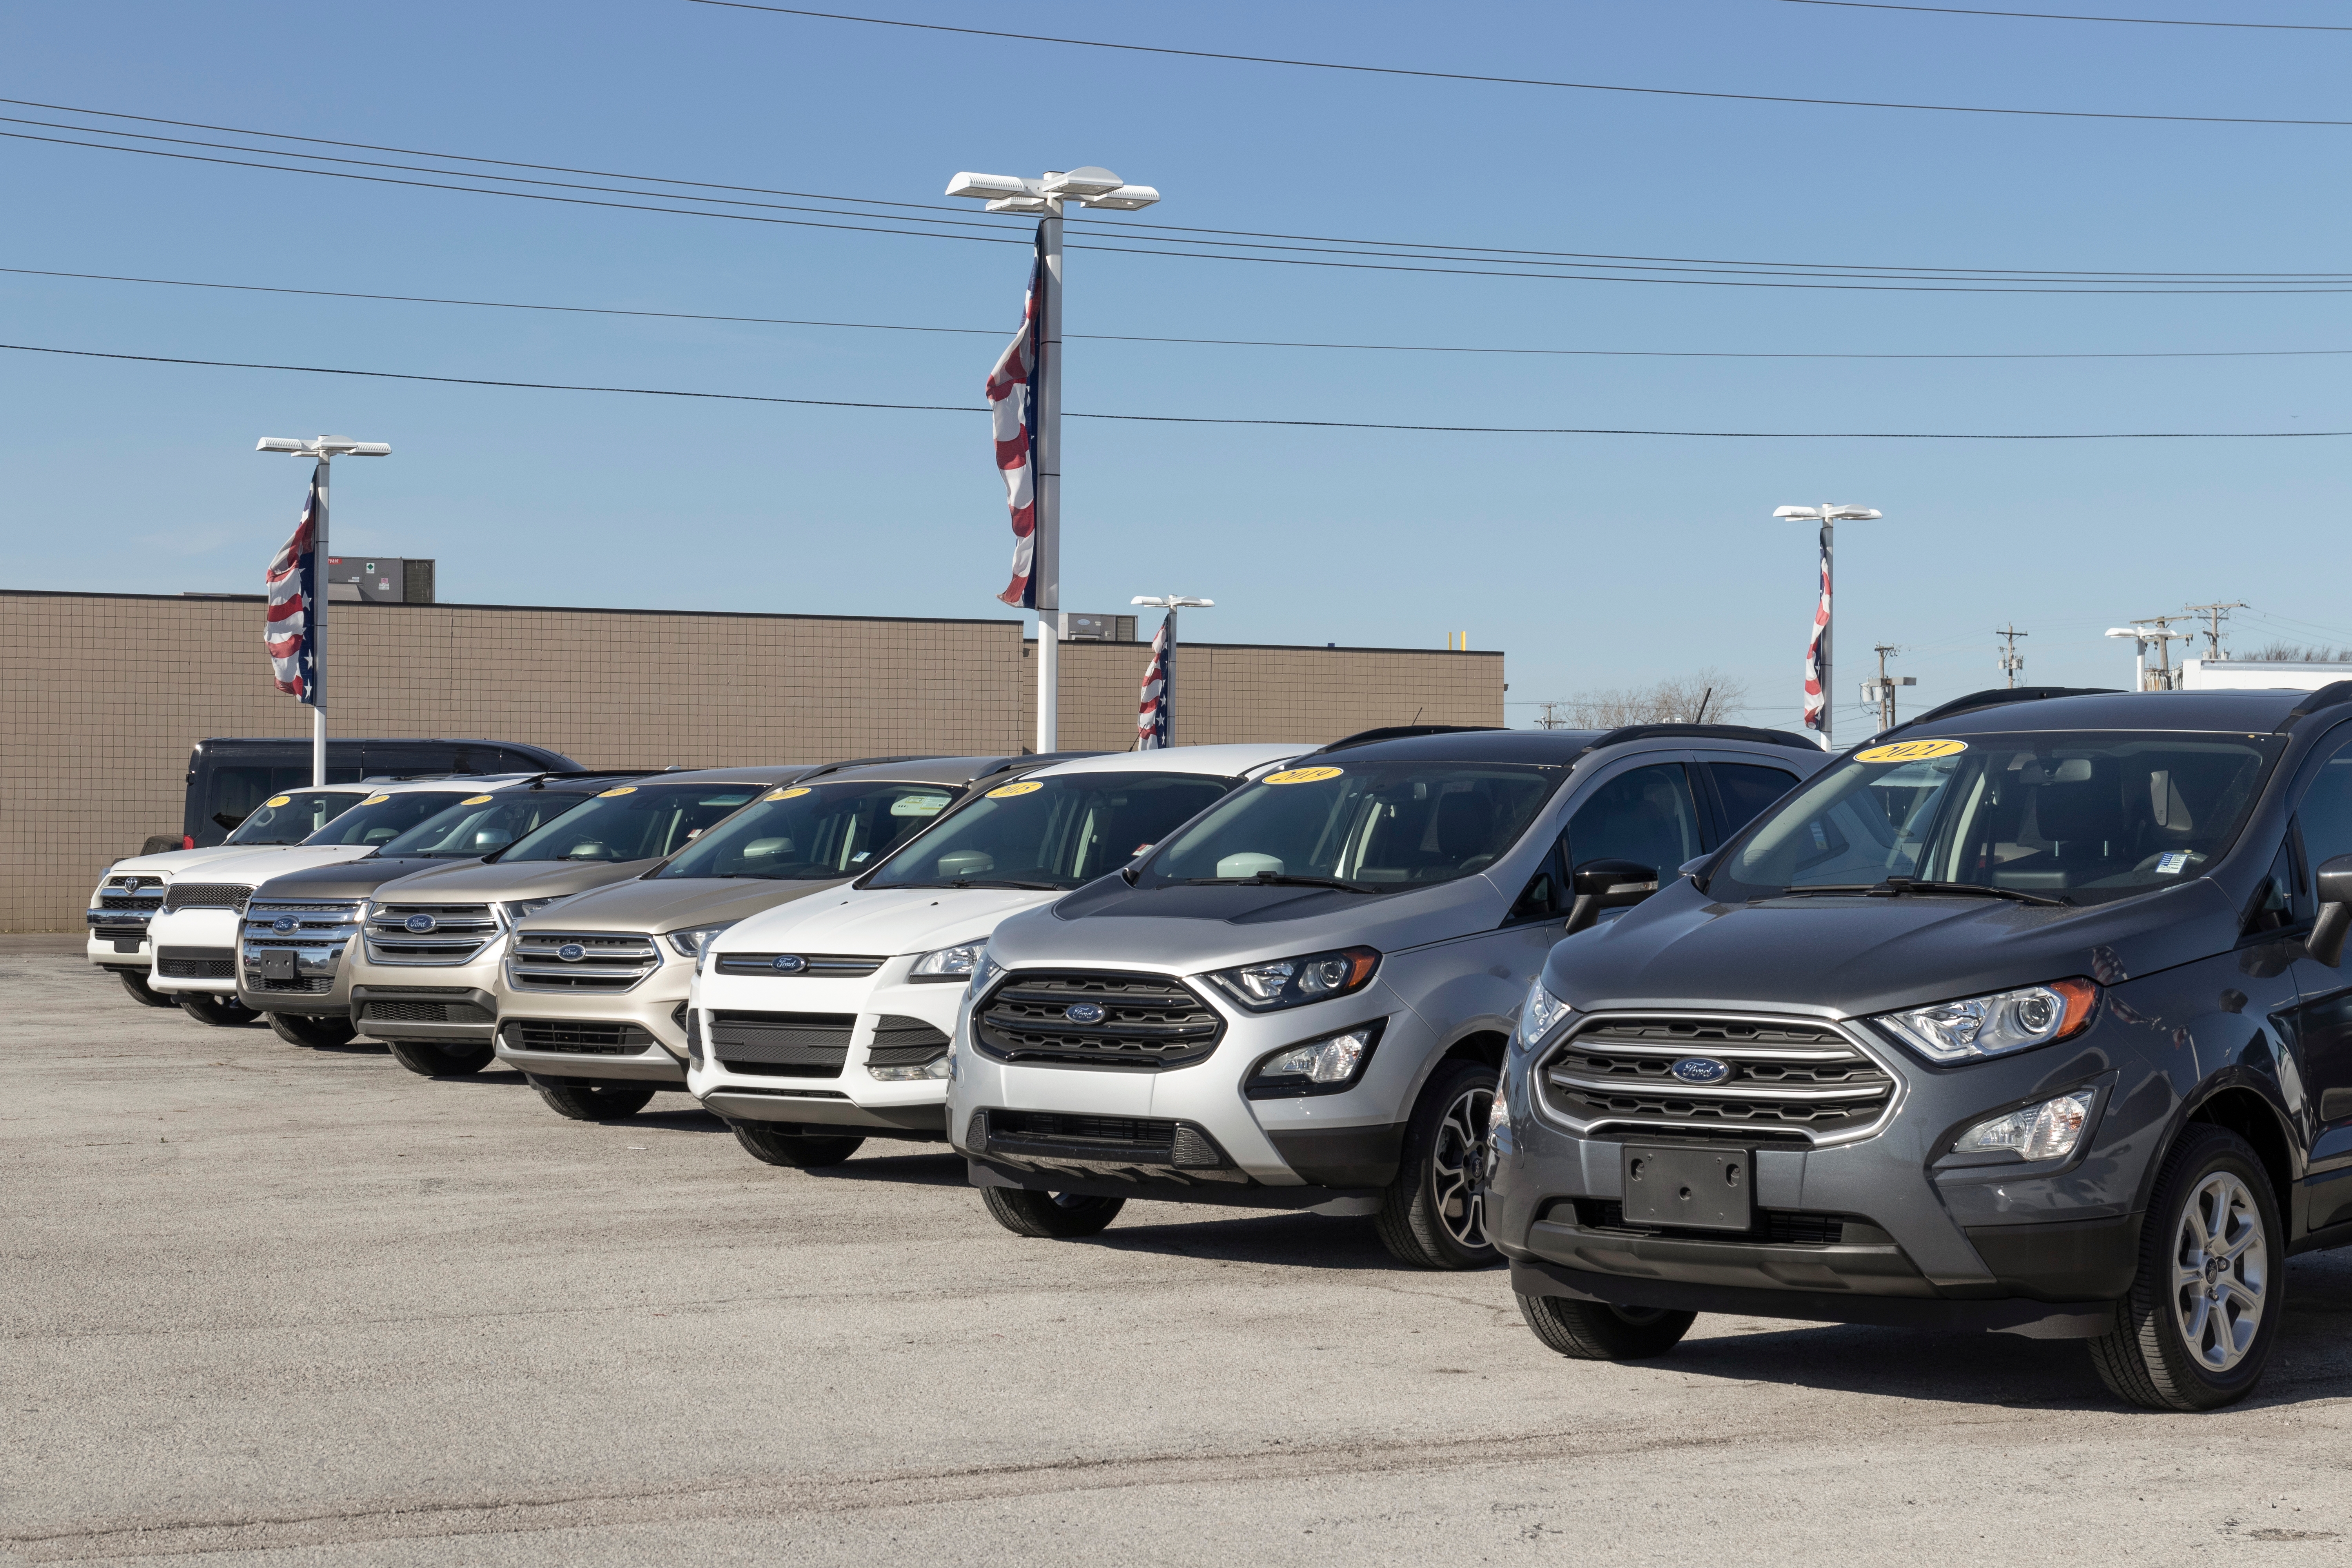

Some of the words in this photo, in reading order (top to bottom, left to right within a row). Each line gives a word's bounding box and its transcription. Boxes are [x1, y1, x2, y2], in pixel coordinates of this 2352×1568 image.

[1866, 743, 1953, 759] 2021
[1270, 769, 1334, 781] 2019
[769, 789, 807, 799] 2017
[990, 784, 1038, 796] 2015
[276, 920, 290, 928] Ford
[410, 918, 427, 927] Ford
[563, 947, 578, 956] Ford
[777, 957, 797, 968] Ford
[1073, 1007, 1094, 1018] Ford
[1682, 1062, 1713, 1078] Ford
